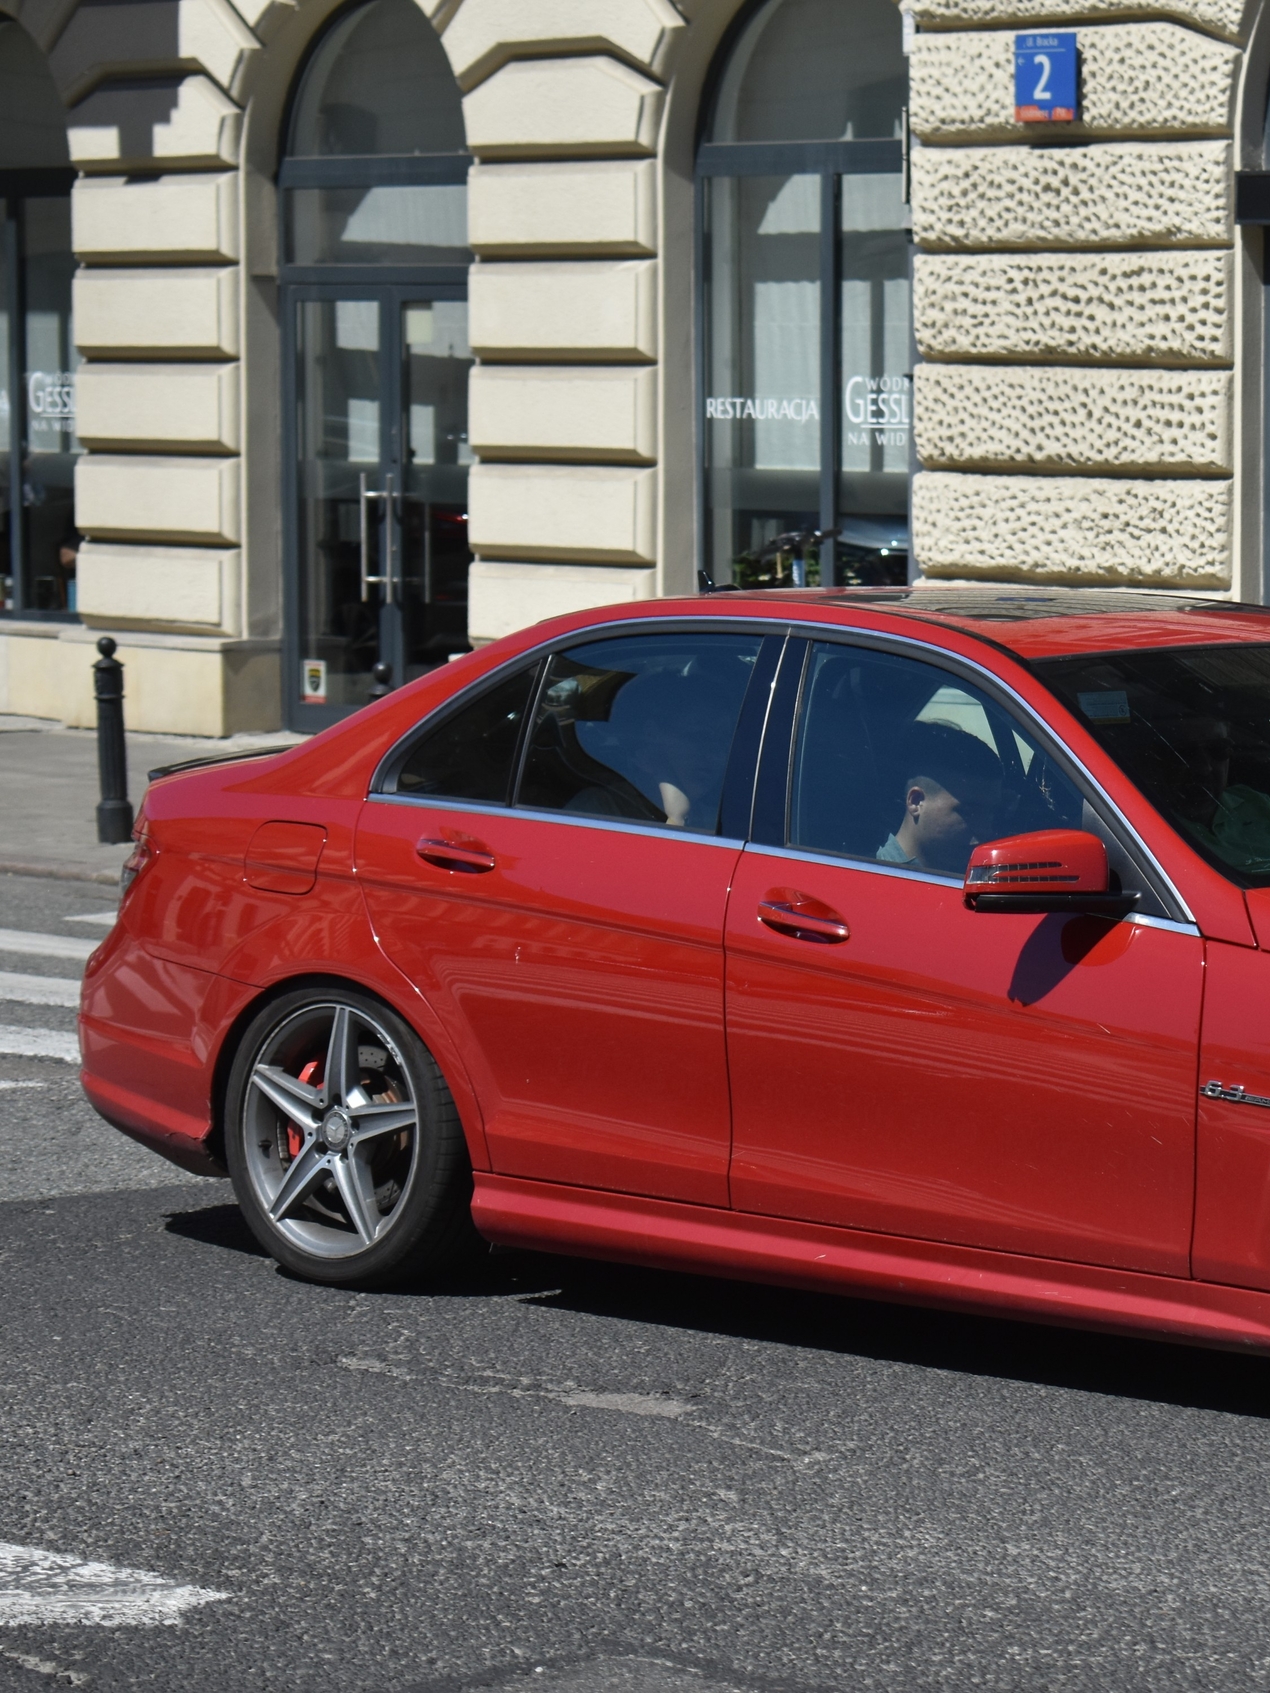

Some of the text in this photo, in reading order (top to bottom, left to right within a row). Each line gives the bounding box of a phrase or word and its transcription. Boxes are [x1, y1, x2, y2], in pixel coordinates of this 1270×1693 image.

[1033, 54, 1052, 100] 2
[706, 398, 819, 424] RESTAURACJA
[848, 432, 870, 446] NA
